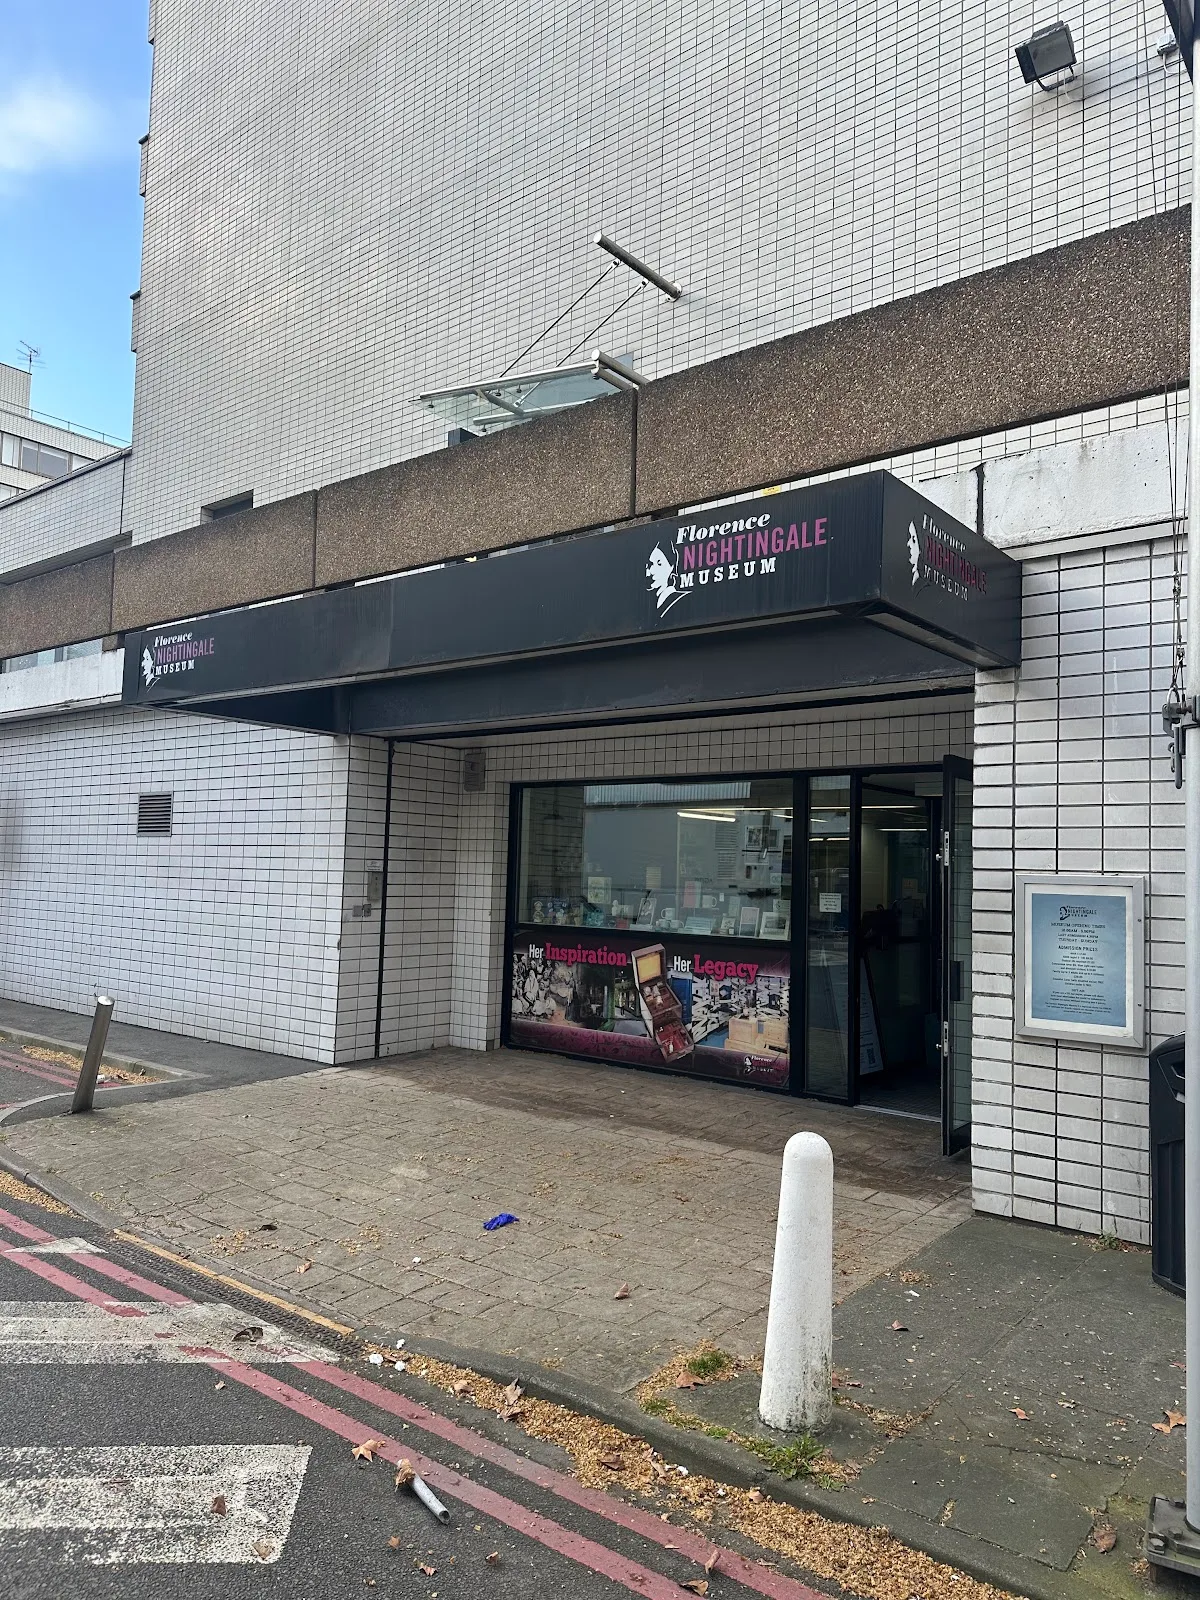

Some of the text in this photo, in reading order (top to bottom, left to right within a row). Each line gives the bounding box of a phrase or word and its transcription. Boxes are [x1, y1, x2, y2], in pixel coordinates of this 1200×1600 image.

[675, 513, 771, 545] Florence
[683, 517, 828, 571] NIGHTINGALE
[922, 514, 966, 552] Florence
[679, 556, 776, 588] MUSEUM
[926, 535, 986, 595] NIGHTINGALE
[923, 564, 968, 601] MUSEUM
[154, 631, 193, 648] Florence
[157, 637, 215, 665] NIGHTINGALE
[155, 659, 195, 676] MUSEUM
[529, 942, 627, 967] Her Inspiration
[673, 954, 759, 984] Her Legacy
